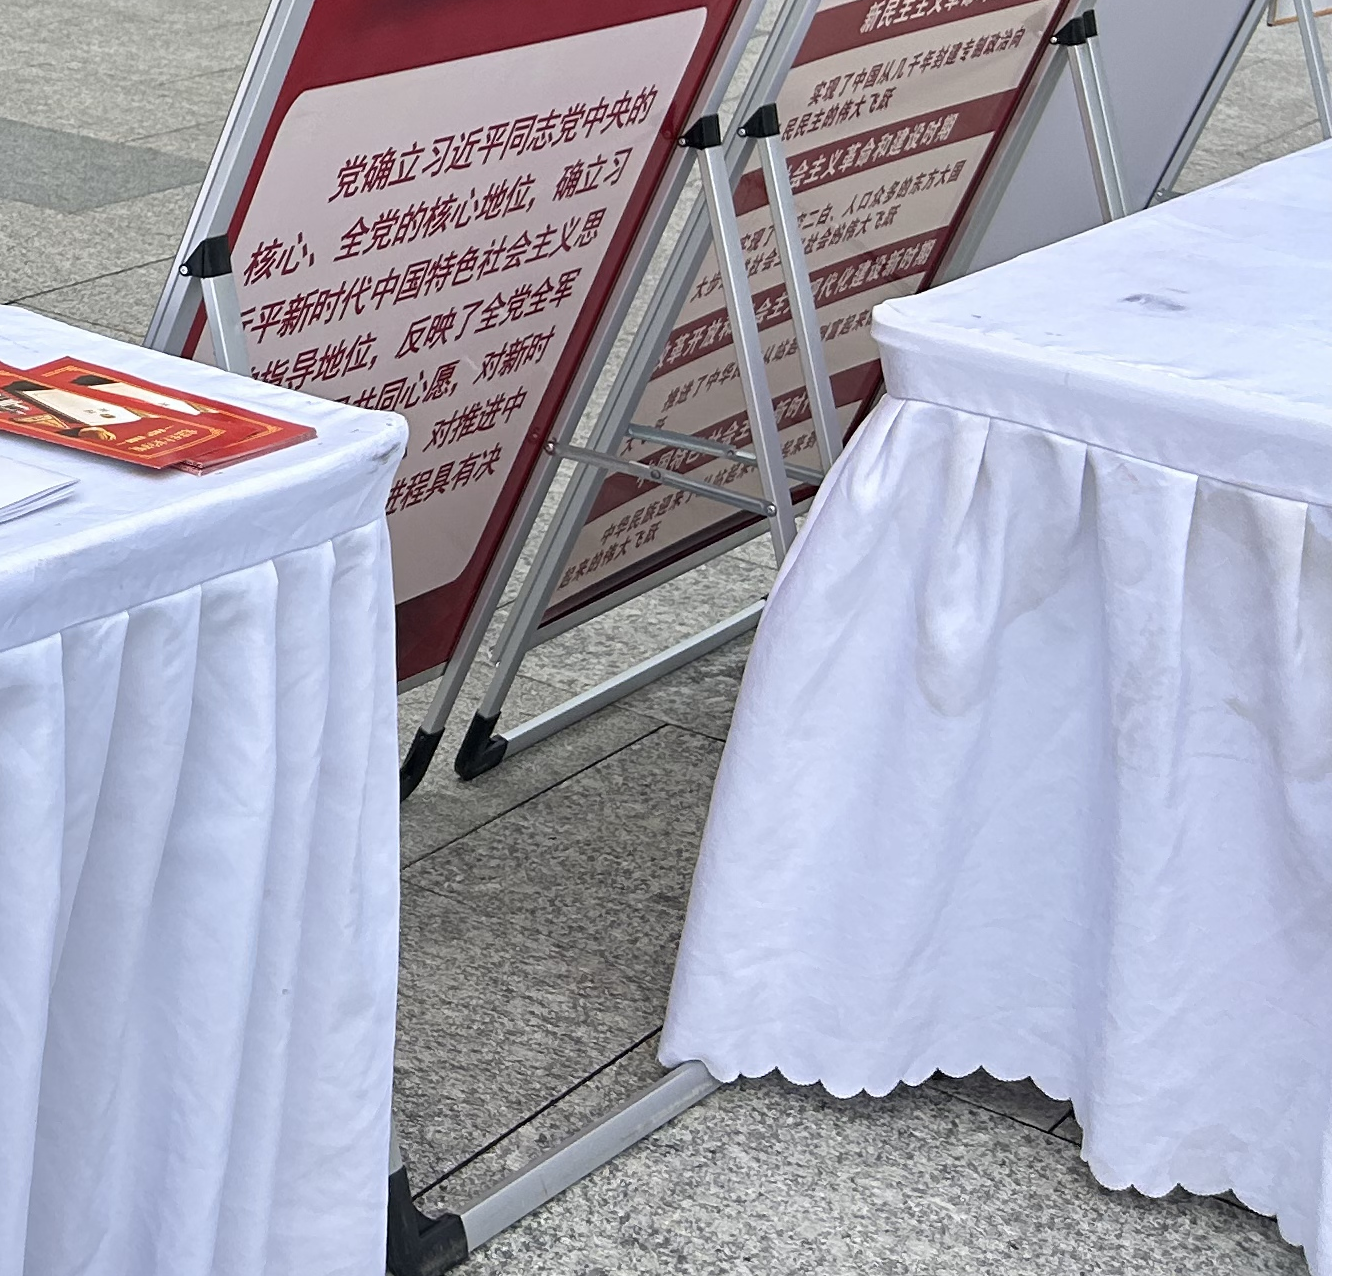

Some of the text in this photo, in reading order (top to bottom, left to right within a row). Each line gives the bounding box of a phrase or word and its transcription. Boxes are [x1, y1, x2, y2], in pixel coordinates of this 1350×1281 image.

[328, 83, 657, 204] 党确立习近平同志党中央的
[779, 86, 896, 142] 民民主的伟大飞跃
[787, 112, 959, 189] 会主义革命和建设时期
[248, 267, 582, 391] 指导地位，反映了全党全军
[335, 327, 555, 411] 共同心愿，对新时
[557, 519, 663, 591] 起来的伟大飞跃
